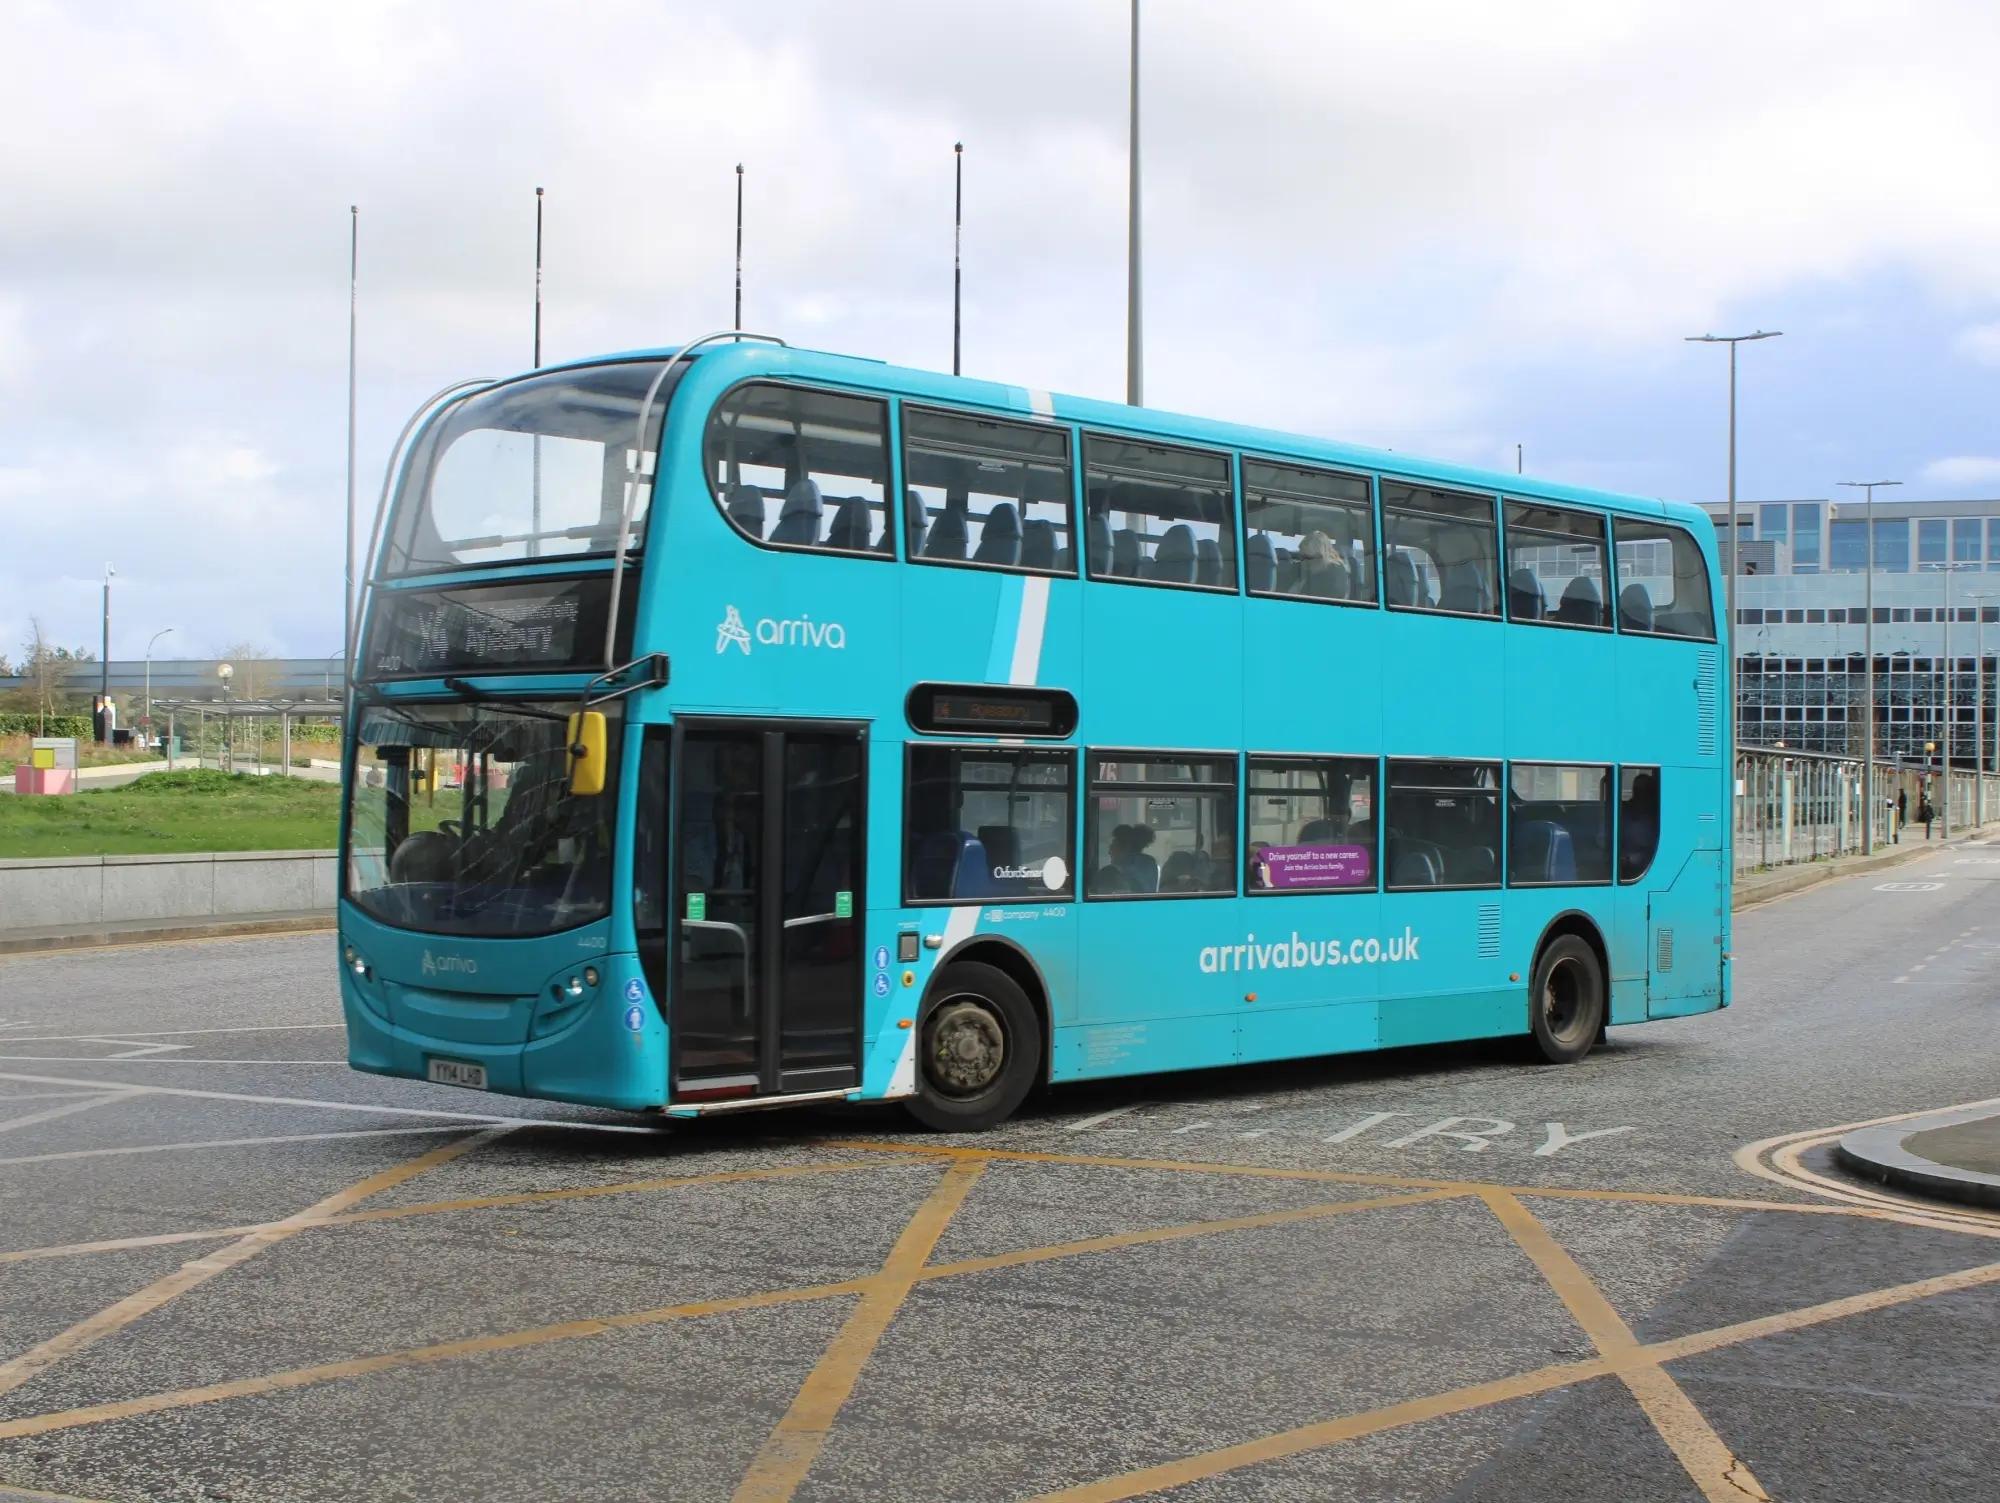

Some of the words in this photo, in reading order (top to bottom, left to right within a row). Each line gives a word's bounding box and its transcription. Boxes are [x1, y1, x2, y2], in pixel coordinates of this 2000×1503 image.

[756, 613, 846, 649] arriva
[1269, 852, 1286, 861] Drive
[1286, 851, 1312, 862] yourself
[1312, 852, 1320, 860] to
[1325, 852, 1339, 860] new
[436, 952, 477, 974] arriva
[1199, 926, 1420, 973] arrivabus.co.uk
